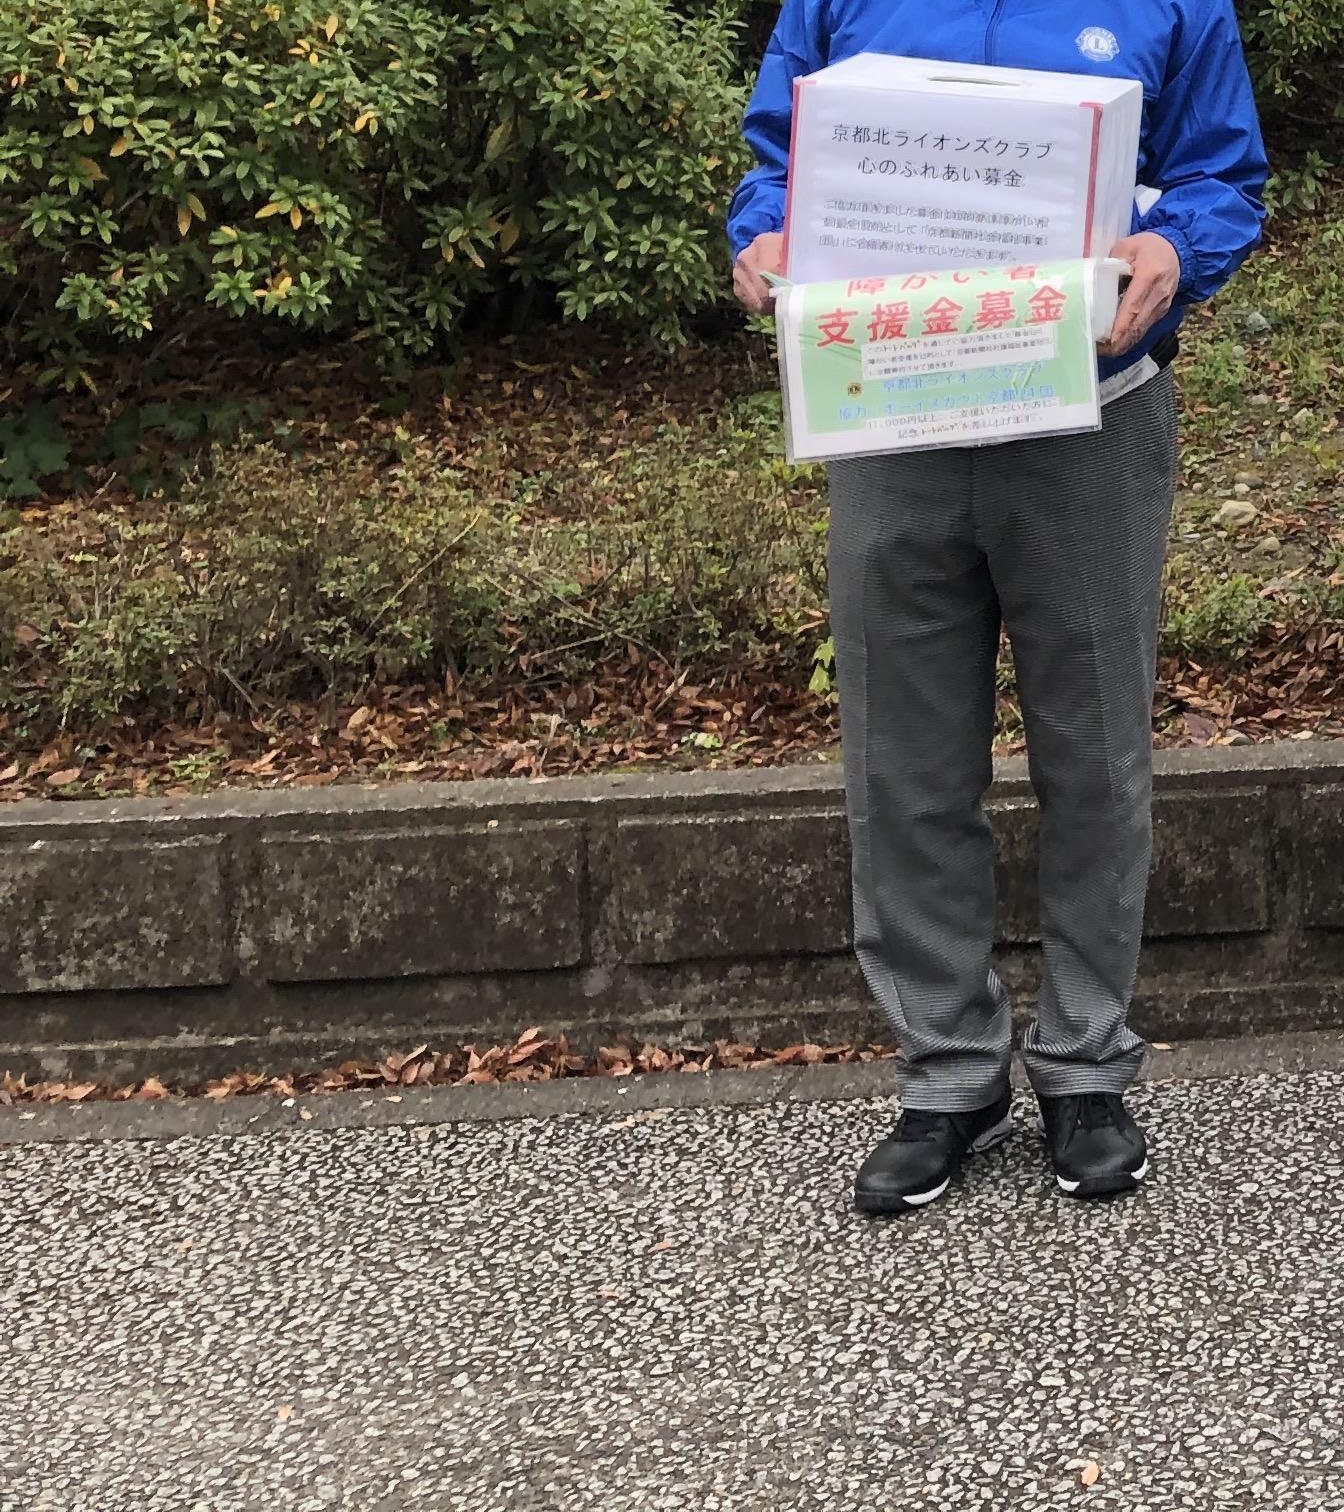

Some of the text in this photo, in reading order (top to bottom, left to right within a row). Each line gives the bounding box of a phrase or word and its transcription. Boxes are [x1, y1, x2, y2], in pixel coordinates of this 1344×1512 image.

[831, 124, 1054, 160] 京都北ライオンズクラブ
[857, 155, 1023, 188] 心のふれあい募金
[815, 284, 1067, 348] 支援金募金
